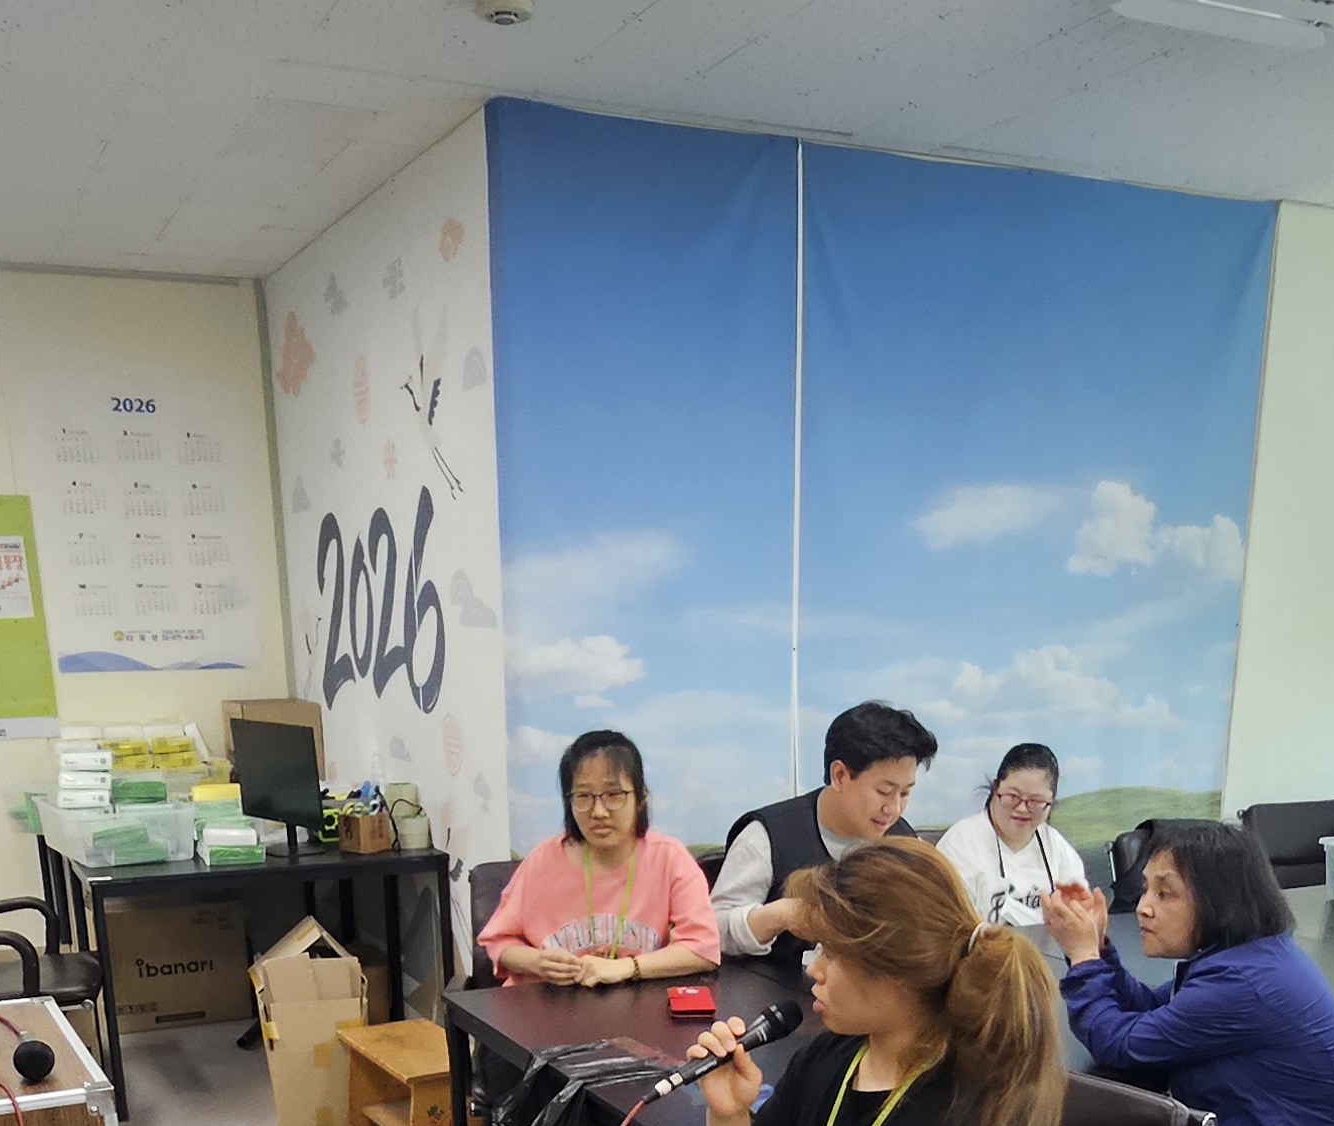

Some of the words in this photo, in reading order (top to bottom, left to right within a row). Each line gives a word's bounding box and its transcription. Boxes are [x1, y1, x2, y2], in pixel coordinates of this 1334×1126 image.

[111, 397, 157, 414] 2026
[317, 485, 445, 714] 2026
[135, 958, 214, 978] ibanari
